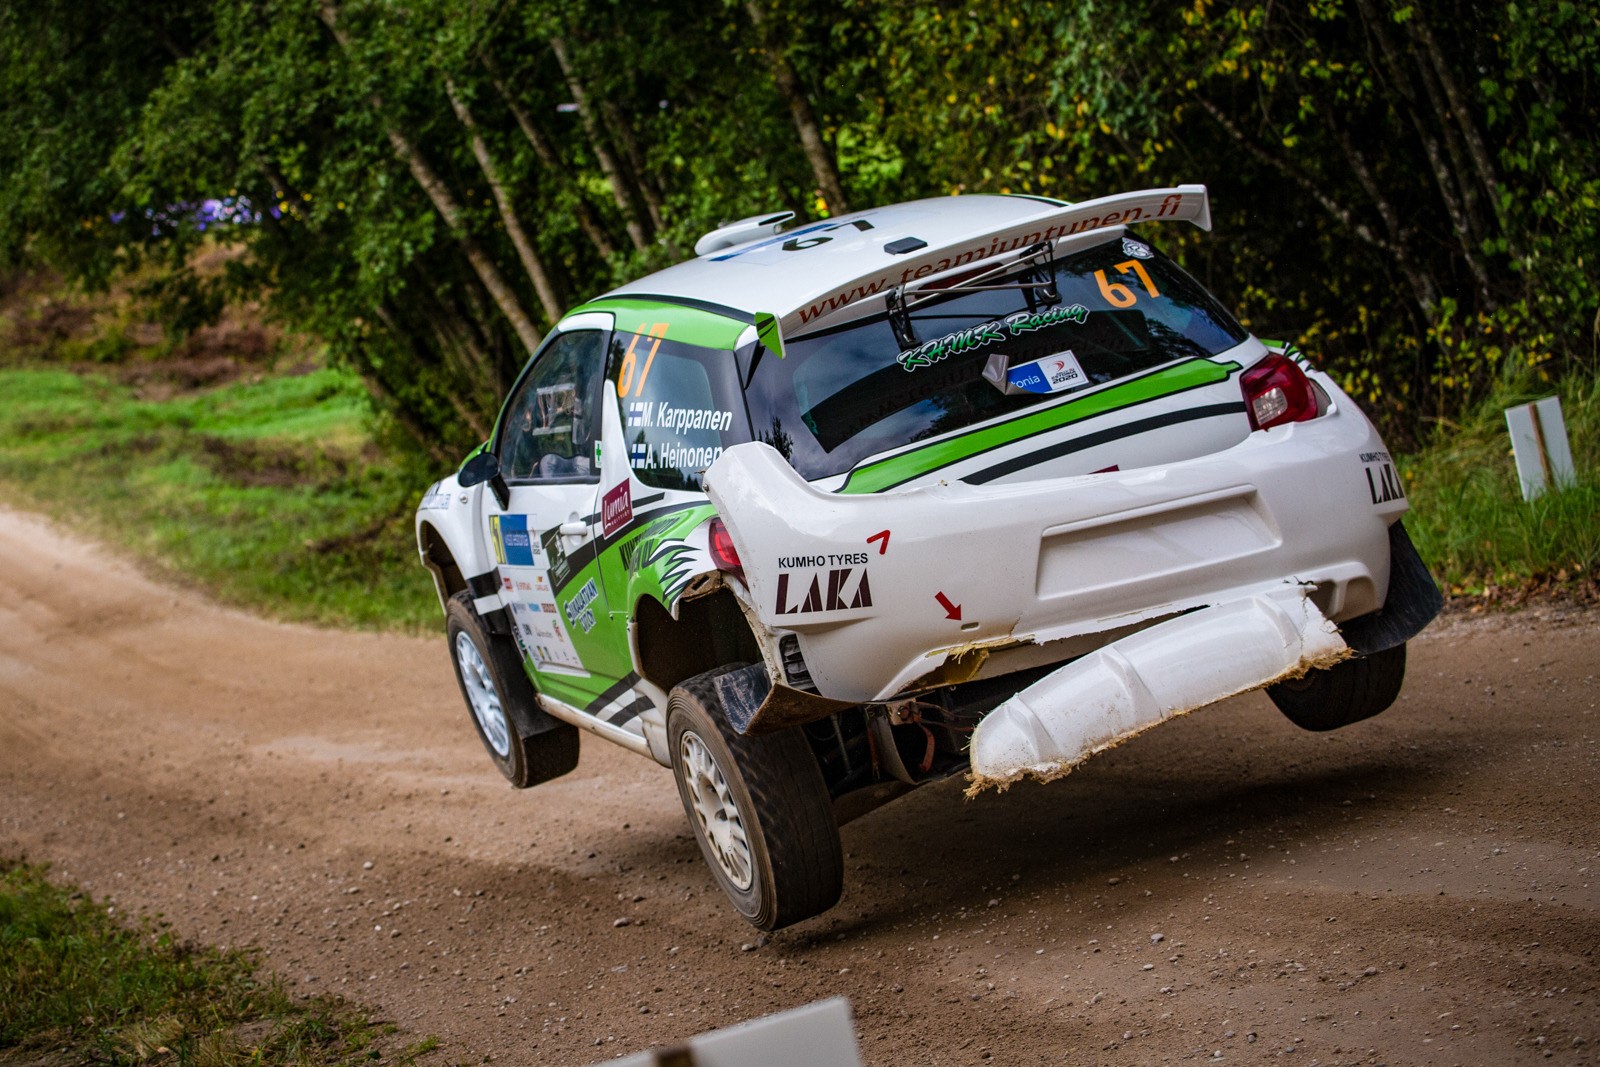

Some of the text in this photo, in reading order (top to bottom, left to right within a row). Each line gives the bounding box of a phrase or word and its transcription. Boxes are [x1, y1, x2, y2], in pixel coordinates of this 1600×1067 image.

[797, 194, 1182, 325] www.teamjuntunen.fi
[1093, 258, 1161, 309] 67
[1005, 303, 1090, 336] Racing
[617, 322, 670, 399] 67
[1052, 373, 1078, 384] 2020
[641, 401, 733, 435] M. Karppanen
[644, 443, 724, 469] A. Heinonen
[1365, 463, 1405, 505] LAKA
[604, 487, 628, 529] Lumia
[778, 552, 869, 568] KUMHO TYRES
[775, 567, 873, 615] LAKA
